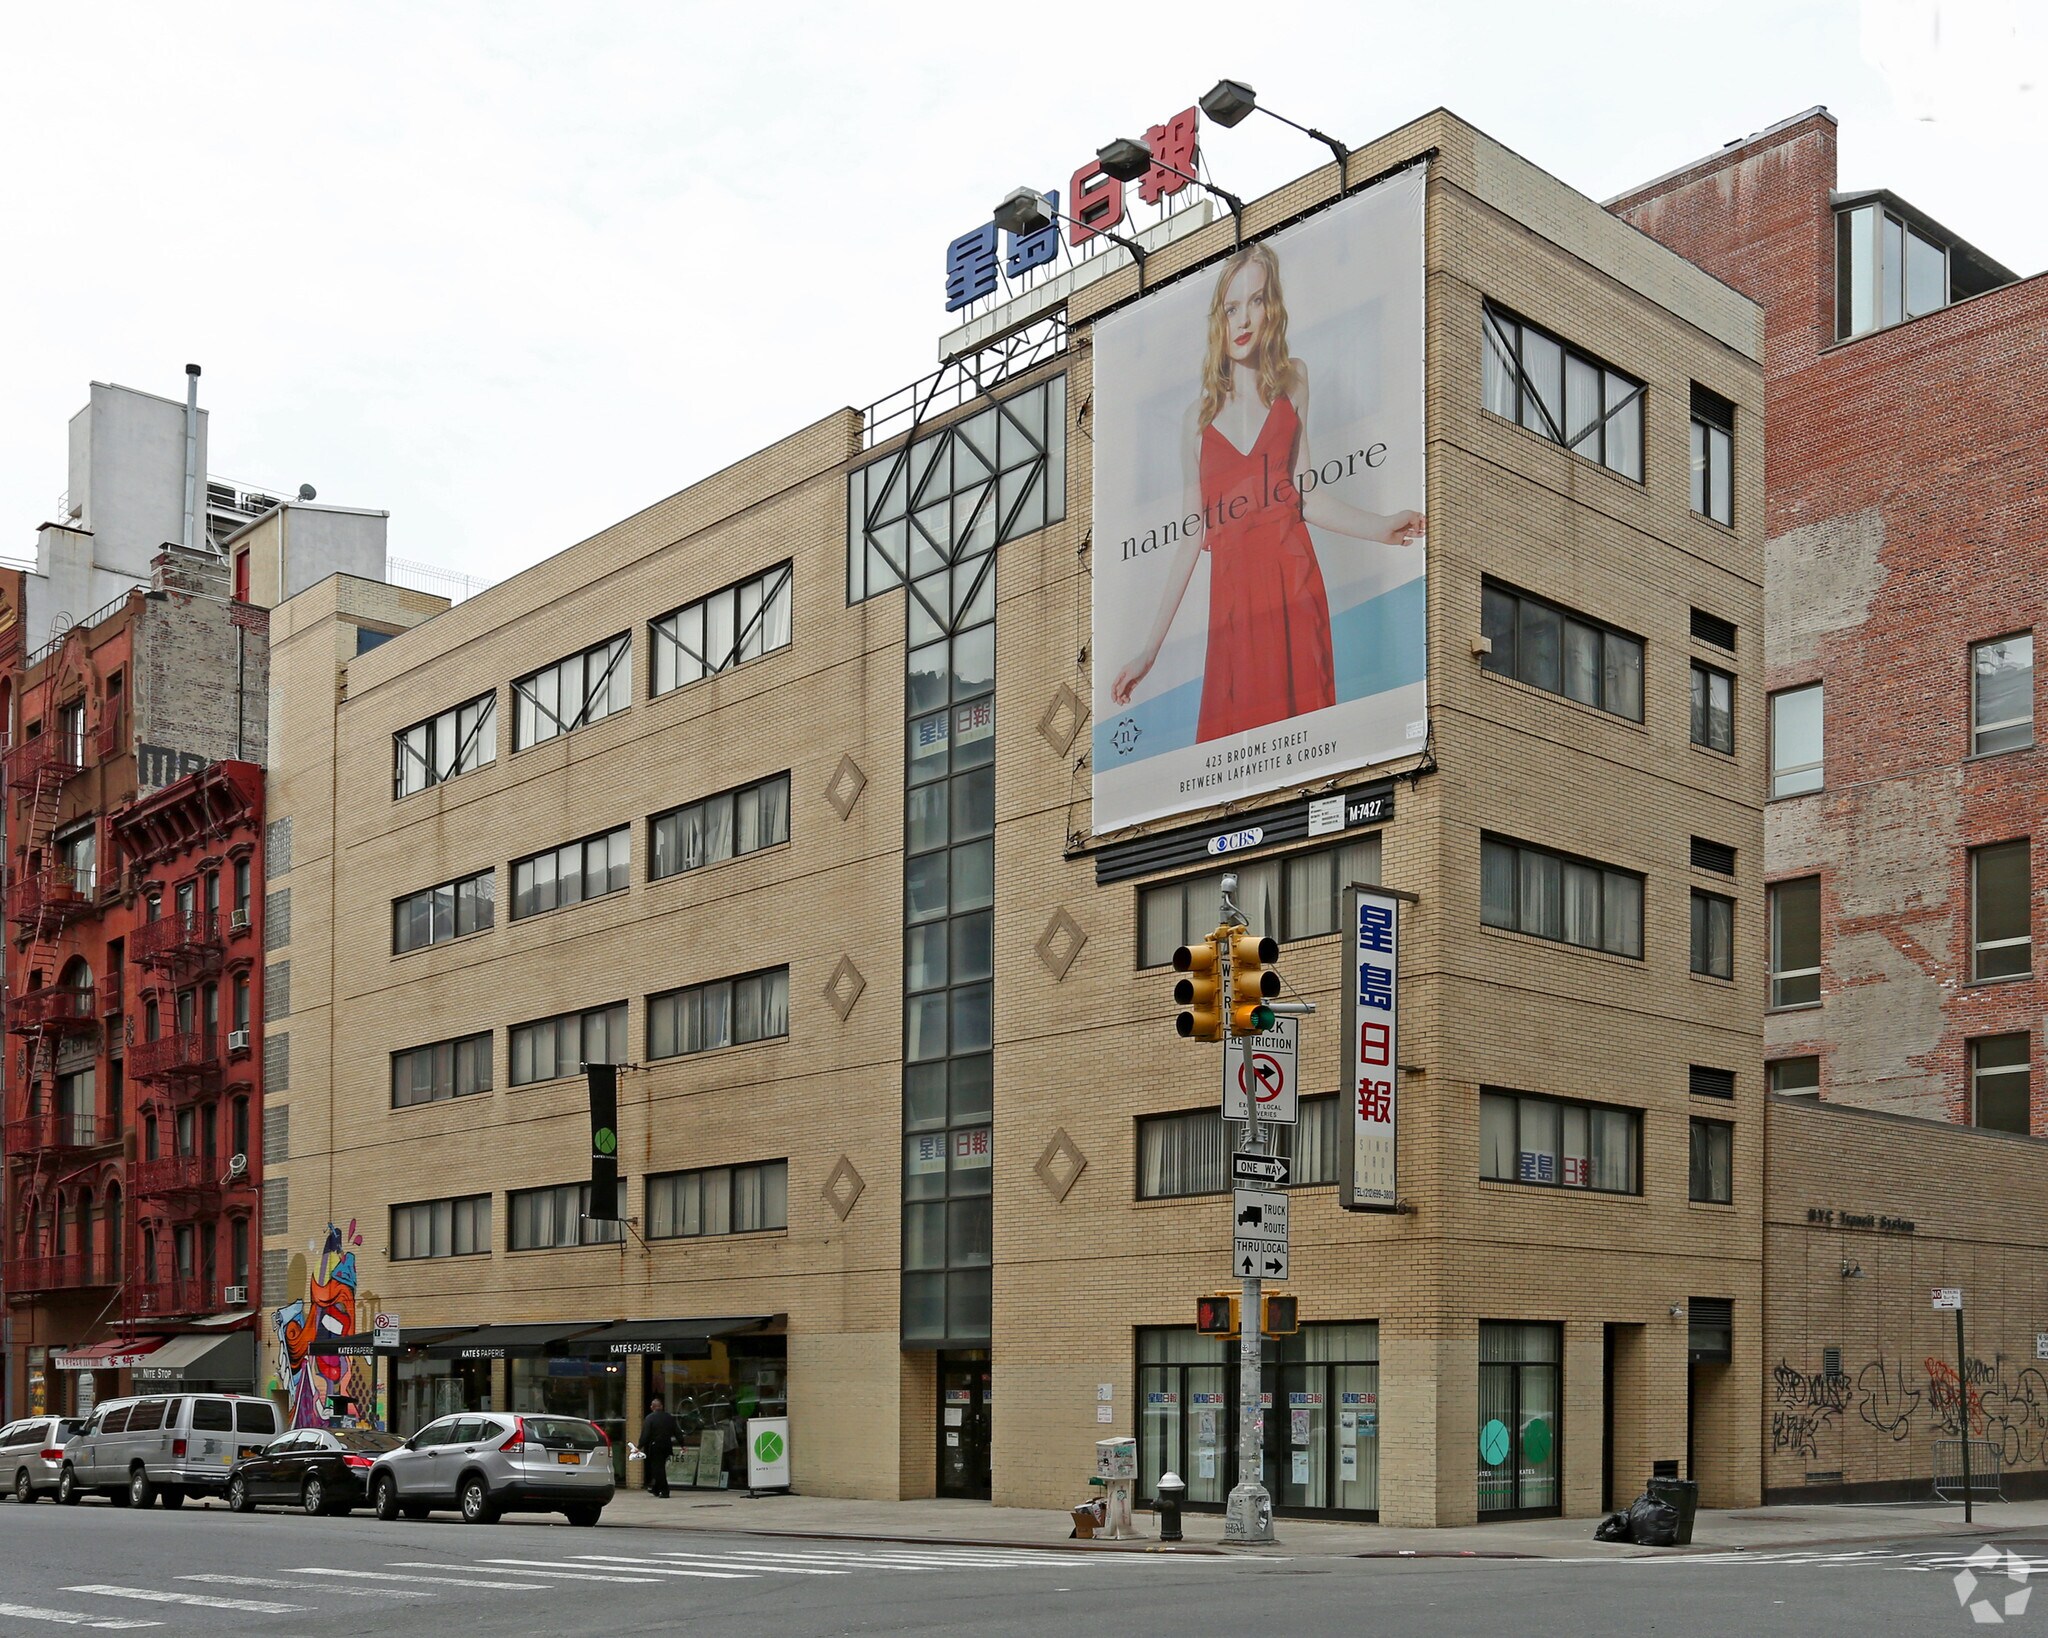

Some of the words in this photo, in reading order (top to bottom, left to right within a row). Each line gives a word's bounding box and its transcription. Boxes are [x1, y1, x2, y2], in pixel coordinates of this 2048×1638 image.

[1120, 492, 1249, 561] nanette
[1261, 441, 1387, 524] lepore
[1205, 754, 1223, 768] 423
[1227, 741, 1267, 763] BROOME
[1272, 730, 1308, 750] STREET
[1180, 772, 1223, 793] BETWEEN
[1228, 756, 1281, 781] LAFAYETTE
[1286, 753, 1293, 766] &
[1297, 741, 1337, 762] CROSBY
[1359, 904, 1393, 1124] 星島日報
[1231, 1035, 1292, 1050] RETRICTION
[1263, 1103, 1282, 1111] LOCAL
[1240, 1161, 1258, 1173] ONE
[1264, 1164, 1282, 1176] WAY
[1264, 1204, 1286, 1216] TRUCK
[1264, 1222, 1286, 1234] ROUTE
[1236, 1241, 1260, 1252] THRU
[1262, 1242, 1287, 1254] LOCAL
[481, 1348, 505, 1358] PAPERIE
[633, 1342, 662, 1352] PAPERIE
[142, 1368, 156, 1379] NITE
[157, 1368, 172, 1379] STOP
